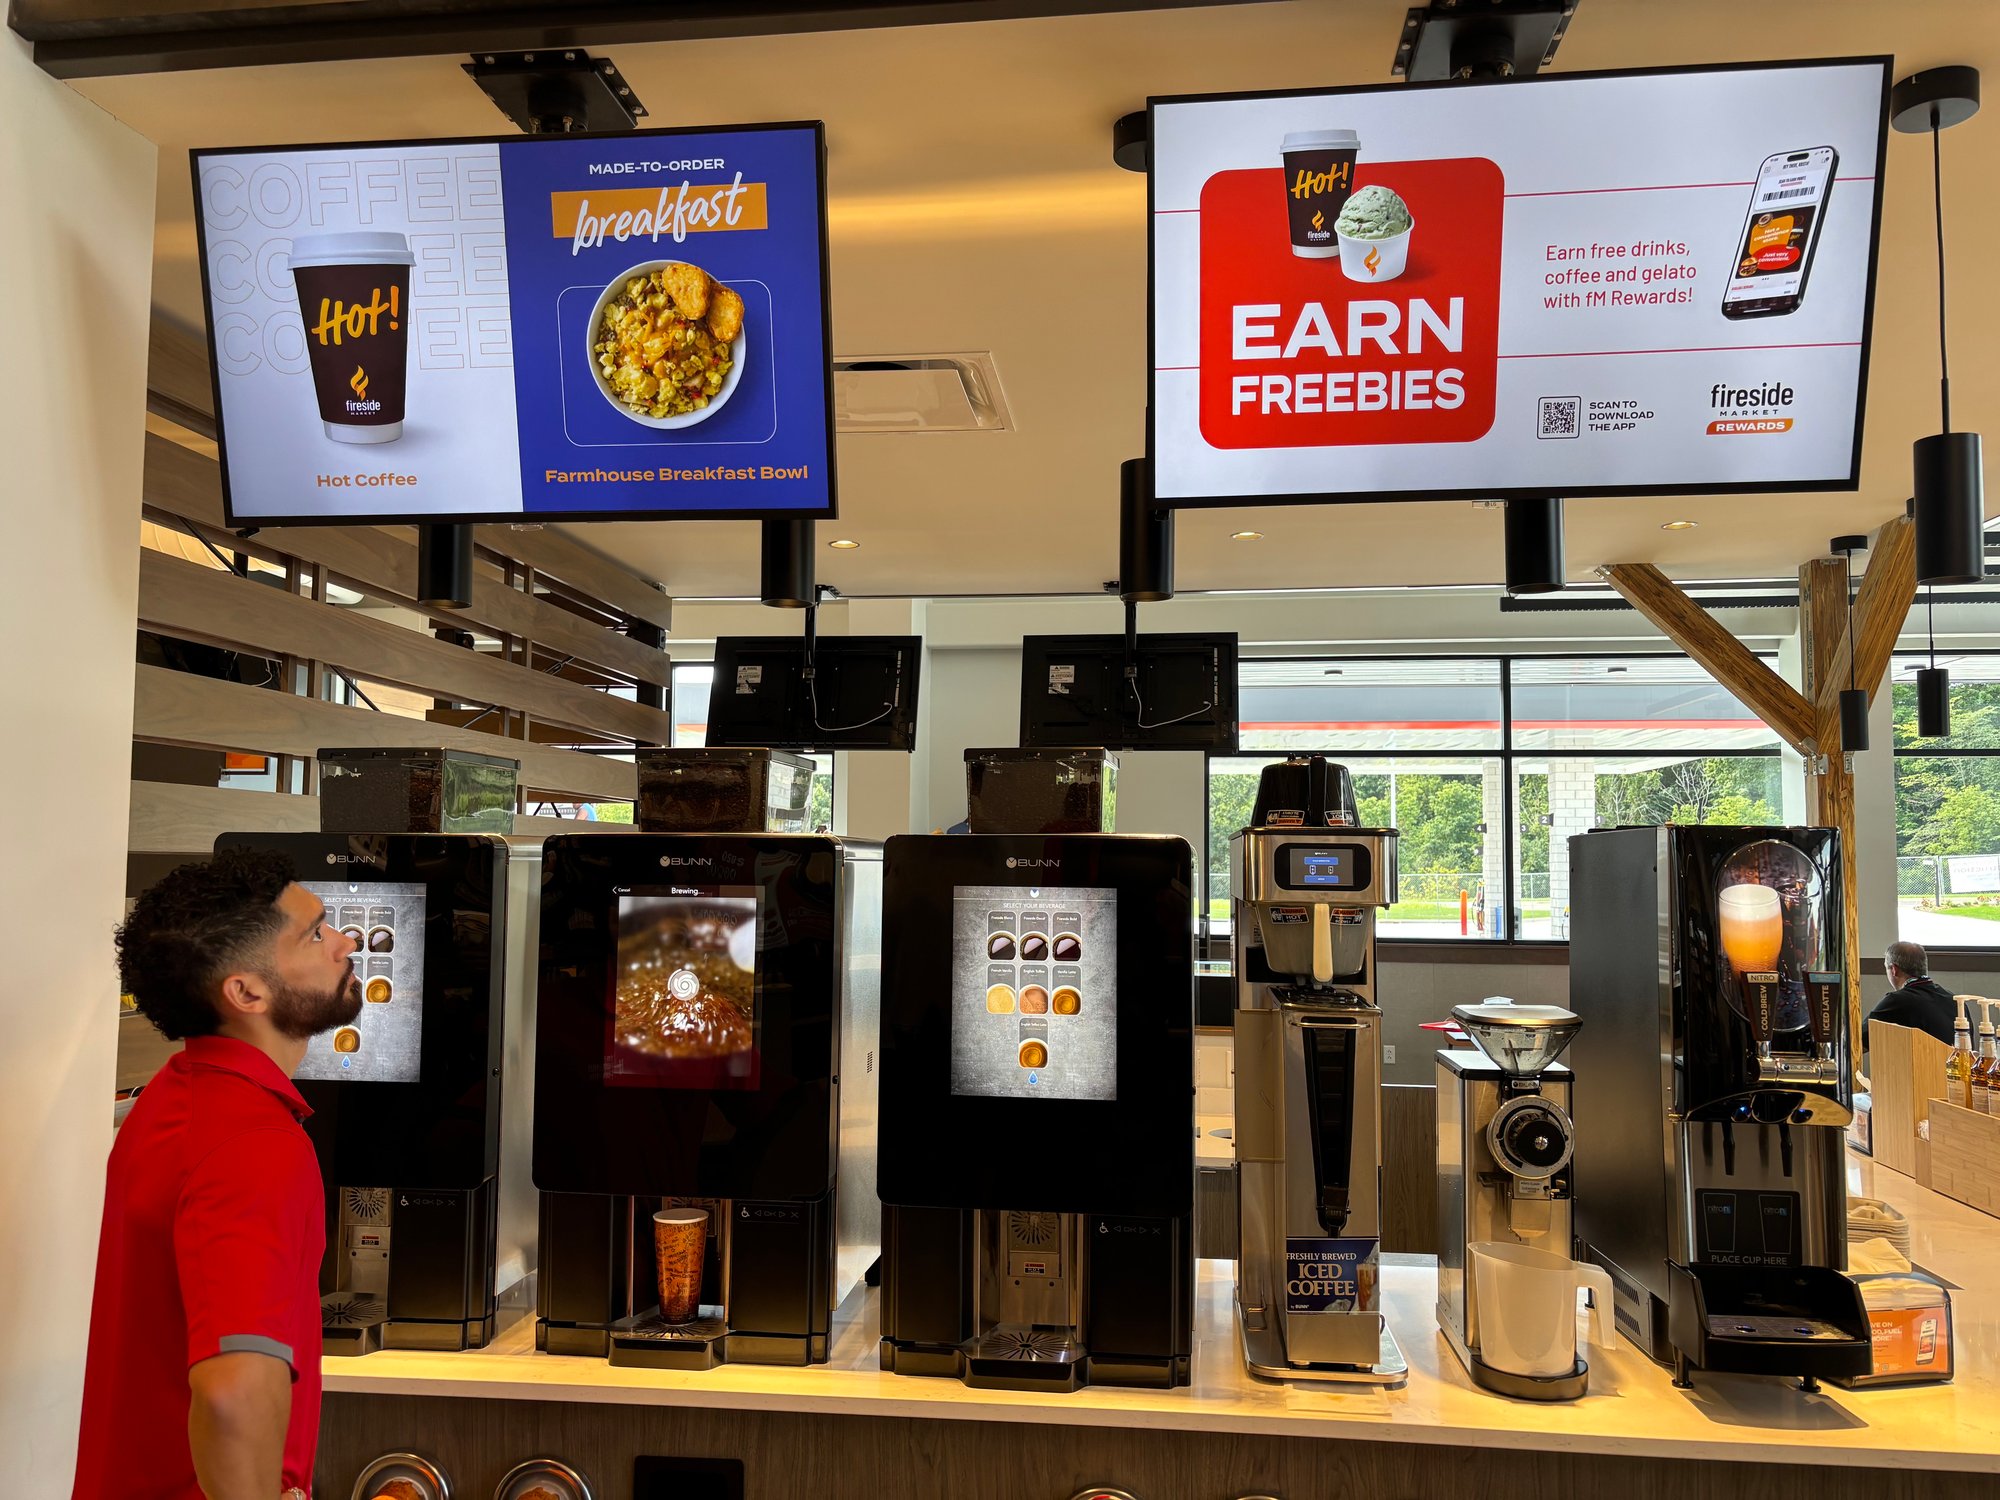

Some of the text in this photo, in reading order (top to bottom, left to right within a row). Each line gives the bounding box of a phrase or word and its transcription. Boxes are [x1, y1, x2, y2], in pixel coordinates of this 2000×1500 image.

[589, 158, 725, 175] MADE-TO-ORDER
[1291, 162, 1349, 199] Hot!
[200, 156, 505, 231] COFFEE
[572, 171, 747, 256] breakfast
[1308, 230, 1330, 239] fireside
[1546, 240, 1690, 261] Earn free drinks,
[208, 232, 509, 304] COEE
[1544, 264, 1697, 285] coffee and gelato
[1544, 287, 1693, 309] with fM Rewards!
[311, 285, 400, 346] Hot!
[1232, 297, 1464, 360] EARN
[214, 306, 514, 376] COEE
[1232, 368, 1465, 416] FREEBIES
[1711, 382, 1794, 408] fireside
[346, 400, 381, 411] fireside
[1589, 400, 1637, 410] SCAN TO
[1719, 409, 1780, 417] MARKET
[1589, 411, 1654, 421] DOWNLOAD
[1588, 422, 1636, 432] THE APP
[1715, 422, 1786, 432] REWARDS
[317, 473, 417, 488] Hot Coffee
[546, 465, 808, 483] Farmhouse Breakfast Bowl
[337, 855, 376, 863] BUNN
[671, 858, 712, 866] BUNN
[1017, 858, 1060, 867] BUNN
[1760, 985, 1768, 1008] BREW
[1822, 985, 1831, 1031] ICED LATTE
[1712, 1255, 1787, 1265] PLACE CUP HERE
[1298, 1263, 1342, 1278] ICED
[1287, 1280, 1356, 1295] COFFEE
